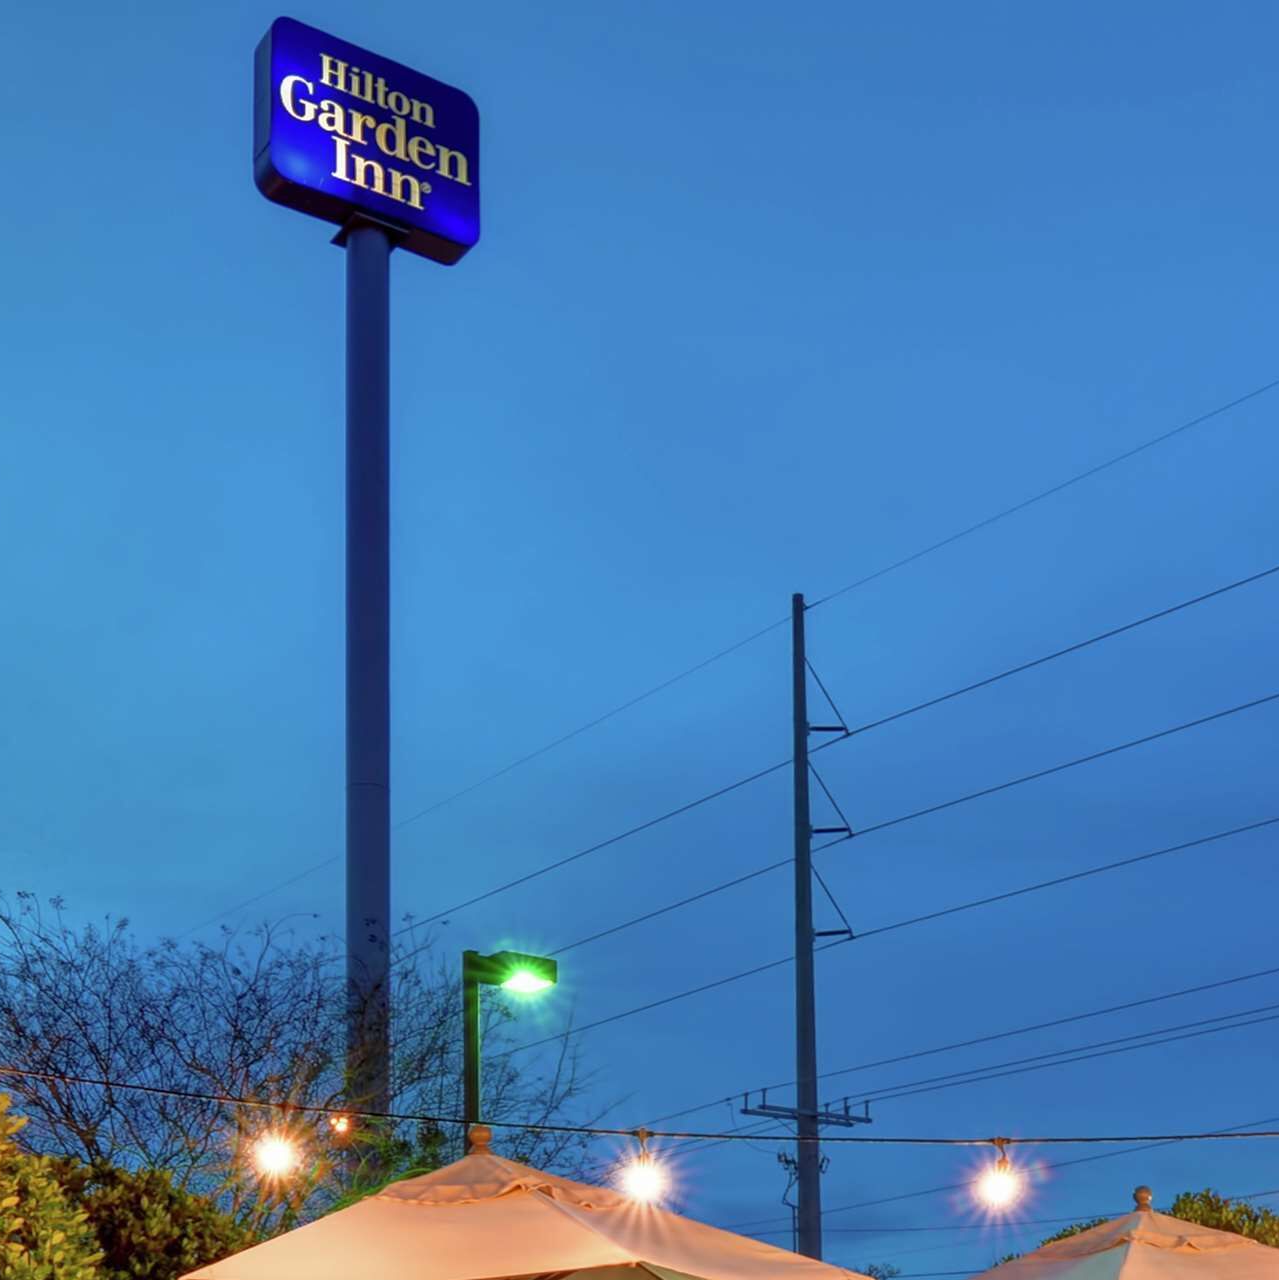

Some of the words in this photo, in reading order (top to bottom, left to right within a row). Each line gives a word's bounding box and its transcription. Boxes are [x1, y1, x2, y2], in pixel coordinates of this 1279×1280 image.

[319, 53, 435, 128] Hilton
[279, 74, 472, 186] Garden
[331, 135, 425, 210] Inn
